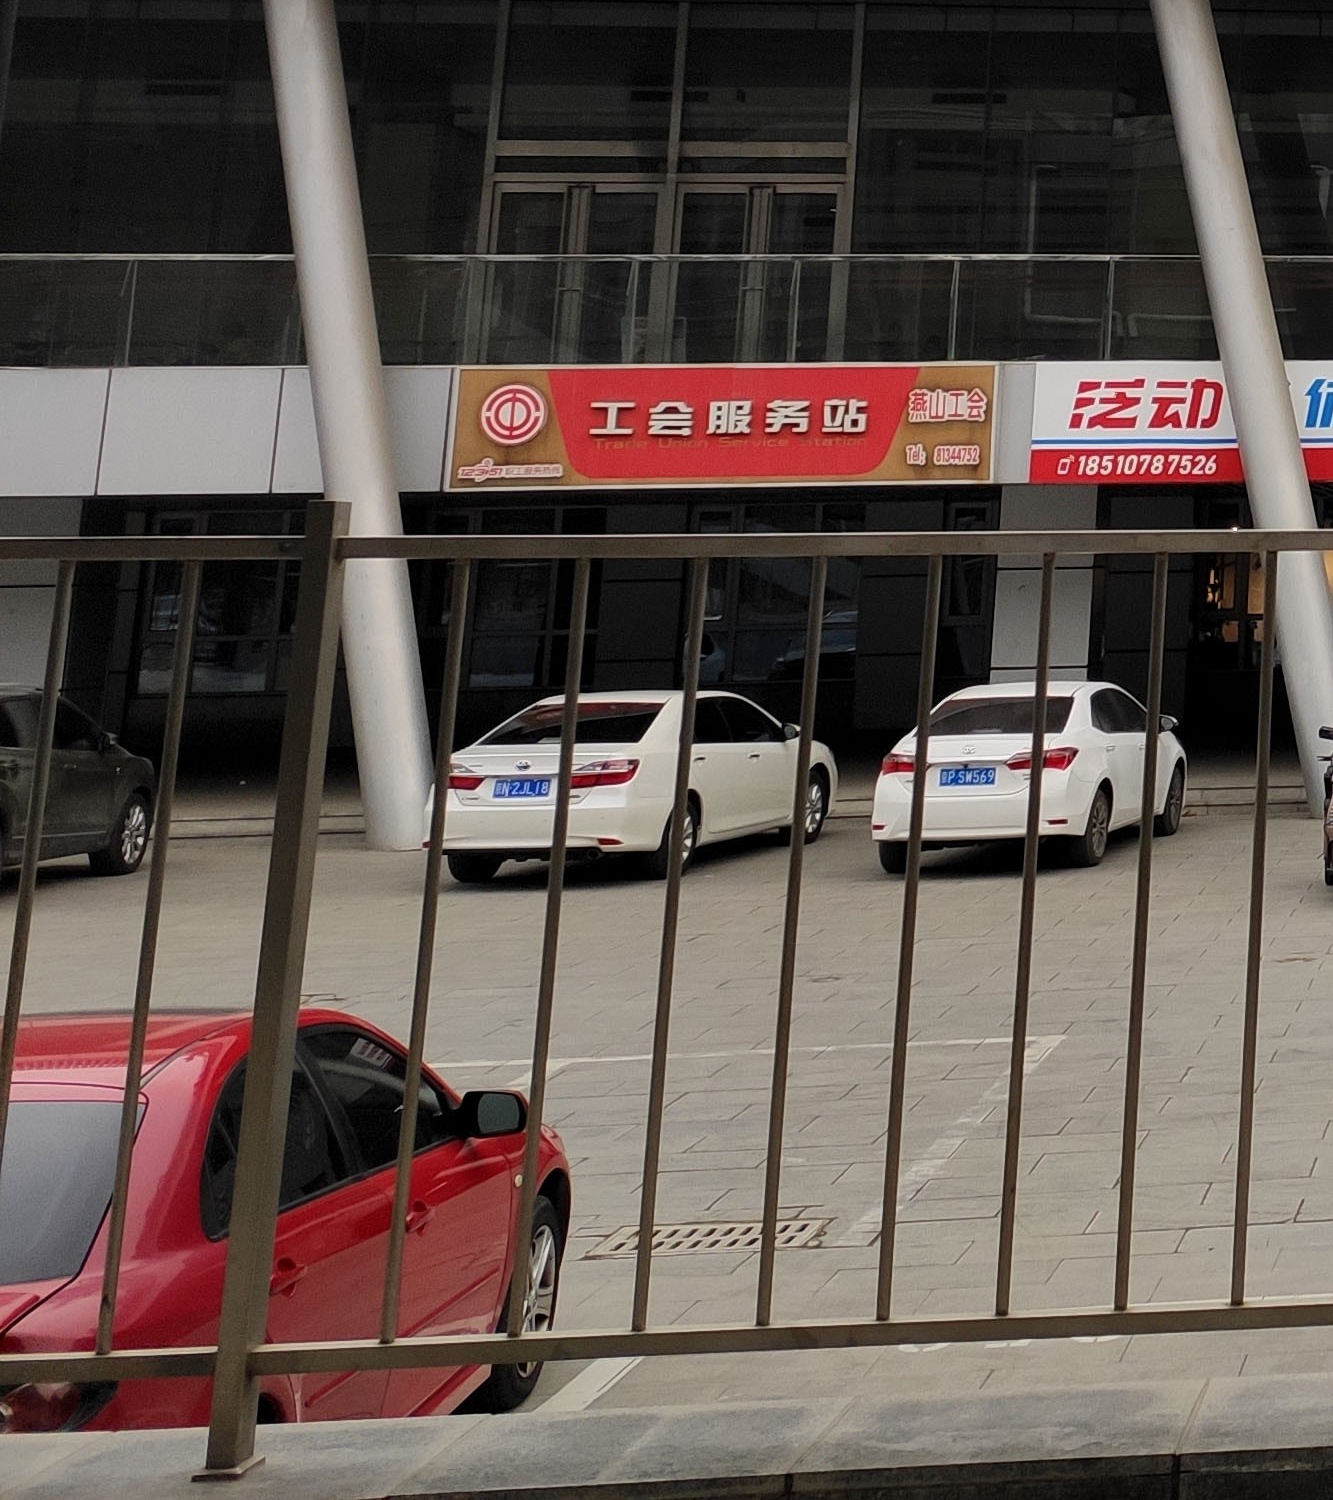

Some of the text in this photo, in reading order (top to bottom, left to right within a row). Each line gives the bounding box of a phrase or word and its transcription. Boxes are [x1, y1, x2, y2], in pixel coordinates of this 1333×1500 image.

[588, 398, 869, 437] 工会服务站
[908, 388, 987, 422] 燕山工会
[1068, 378, 1224, 430] 泛动
[934, 446, 979, 464] 81344752
[1077, 454, 1218, 476] 18510787526
